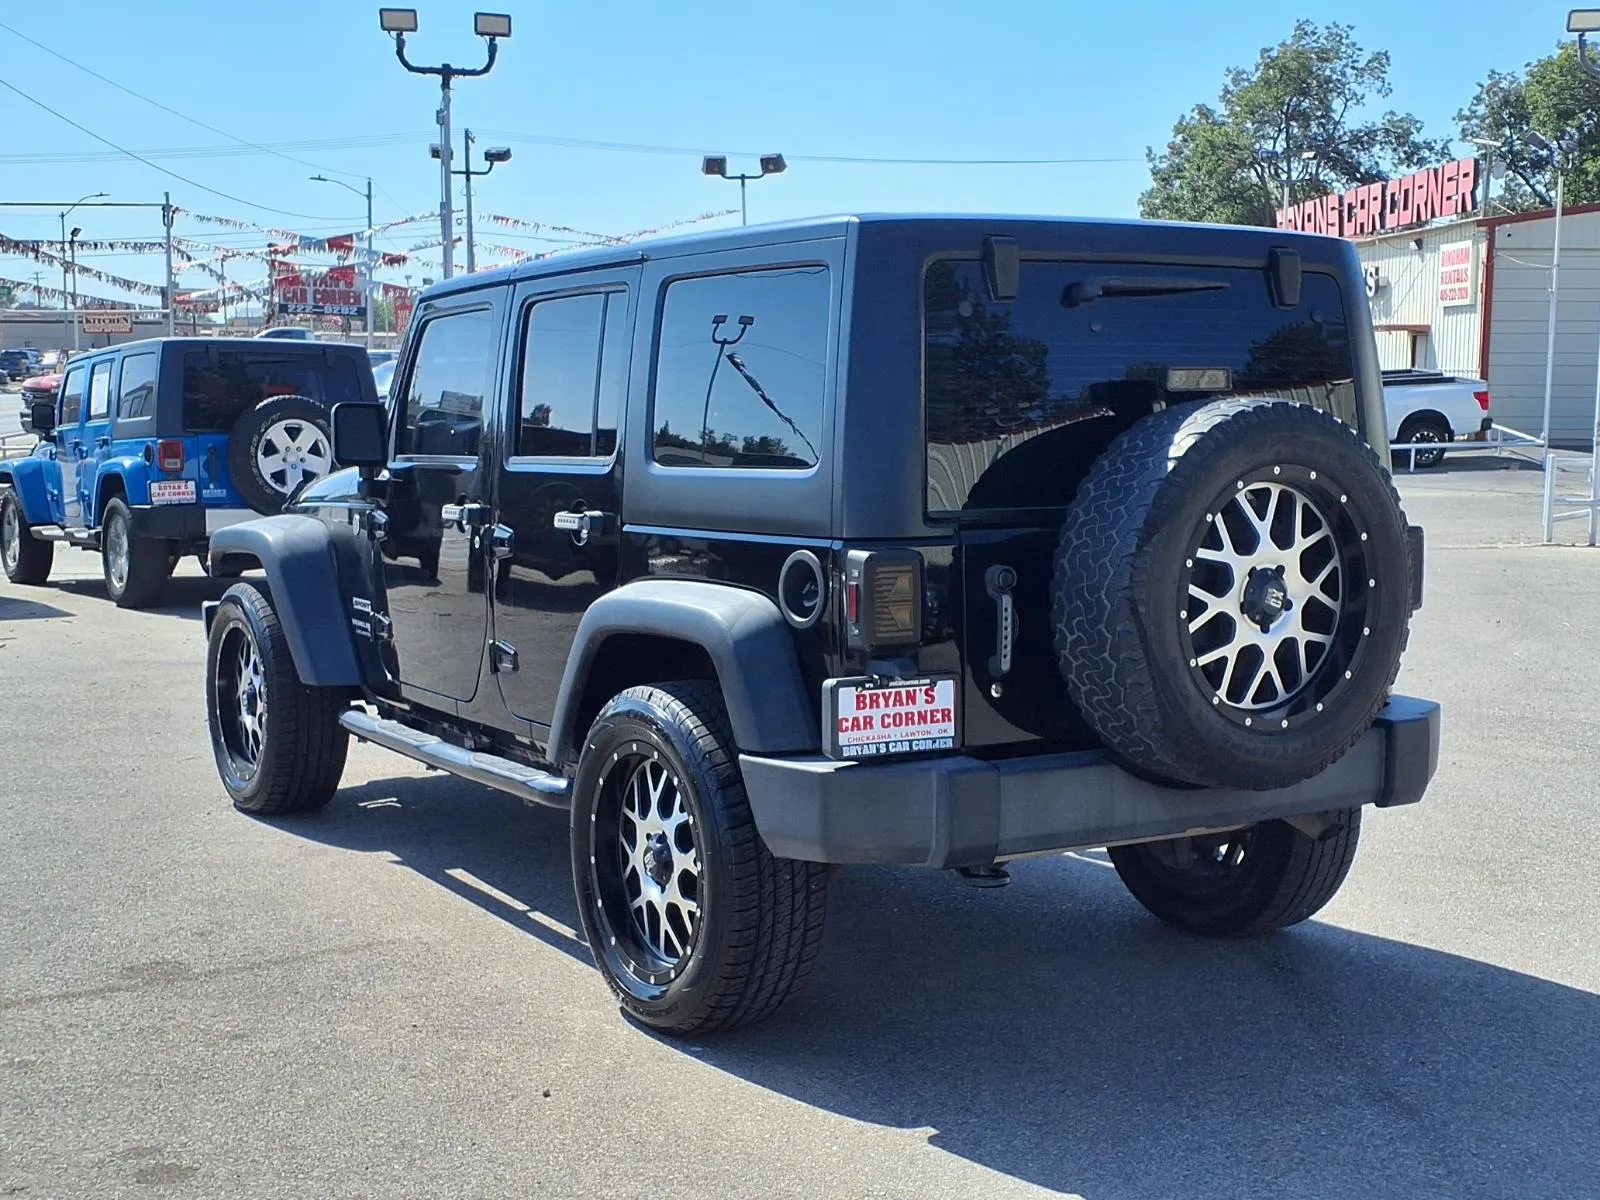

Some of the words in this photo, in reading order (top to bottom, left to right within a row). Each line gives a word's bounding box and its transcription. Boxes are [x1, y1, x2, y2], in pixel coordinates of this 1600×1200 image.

[1343, 181, 1382, 236] CAR
[1385, 158, 1476, 229] CORNER
[1440, 268, 1469, 285] RENTALS
[85, 316, 129, 324] KITCHEN
[855, 687, 936, 711] BRYAN'S
[837, 715, 874, 733] CAR
[880, 708, 953, 729] CORNER
[847, 733, 892, 744] CHICKASHA
[842, 743, 886, 757] BRYAN'S
[888, 740, 910, 752] CAR
